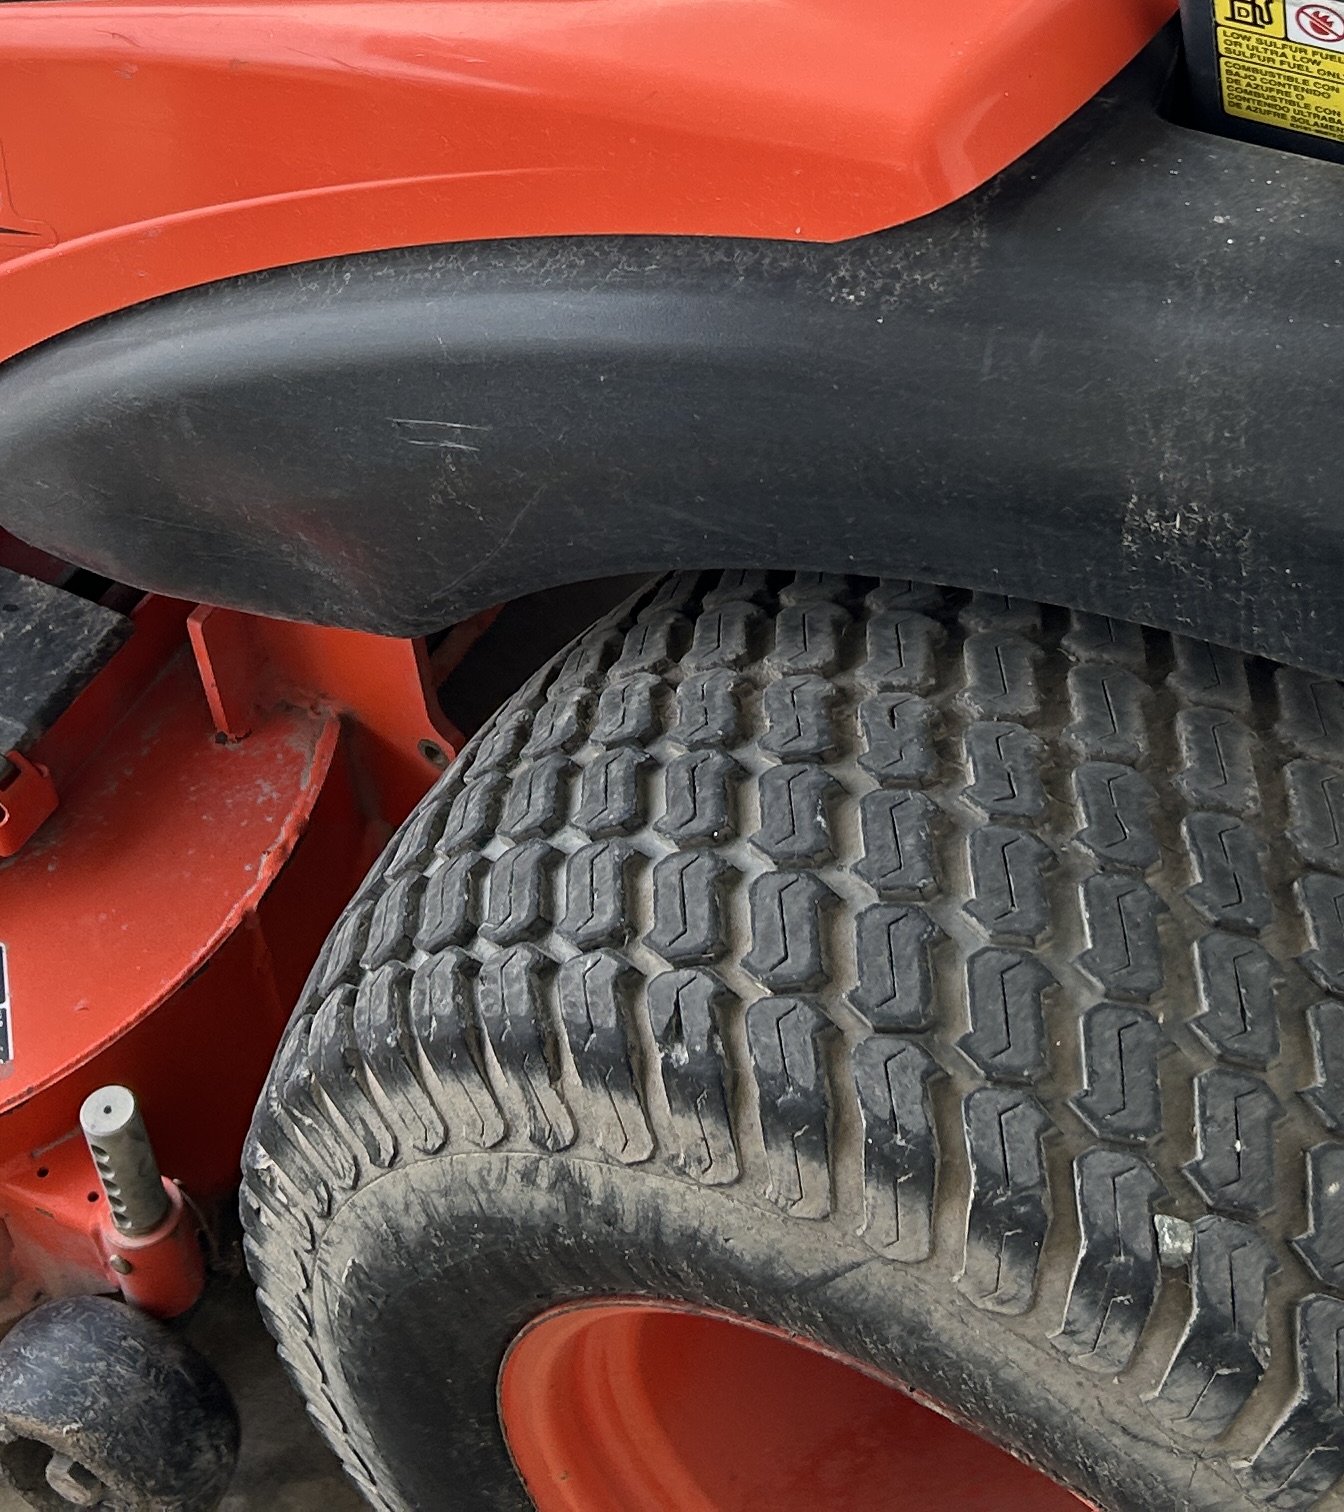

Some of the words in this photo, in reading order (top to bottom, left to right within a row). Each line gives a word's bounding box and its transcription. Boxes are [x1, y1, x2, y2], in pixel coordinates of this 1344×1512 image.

[1222, 29, 1251, 42] LOW
[1254, 36, 1308, 55] SULFUR
[1223, 38, 1242, 48] OR
[1246, 43, 1287, 59] ULTRA
[1292, 54, 1321, 66] LOW
[1224, 46, 1275, 65] SULFUR
[1279, 59, 1313, 73] FUEL
[1224, 60, 1309, 86] COMBUSTIBLE
[1313, 80, 1339, 93] CON
[1225, 68, 1256, 82] BAJO
[1259, 76, 1330, 99] CONTENIDO
[1225, 76, 1242, 86] DE
[1244, 81, 1291, 98] AZUFRE
[1295, 93, 1304, 101] O
[1226, 84, 1311, 110] COMBUSTIBLE
[1314, 105, 1340, 117] CON
[1227, 92, 1289, 113] CONTENIDO
[1227, 100, 1241, 109] DE
[1245, 104, 1287, 120] AZUFRE
